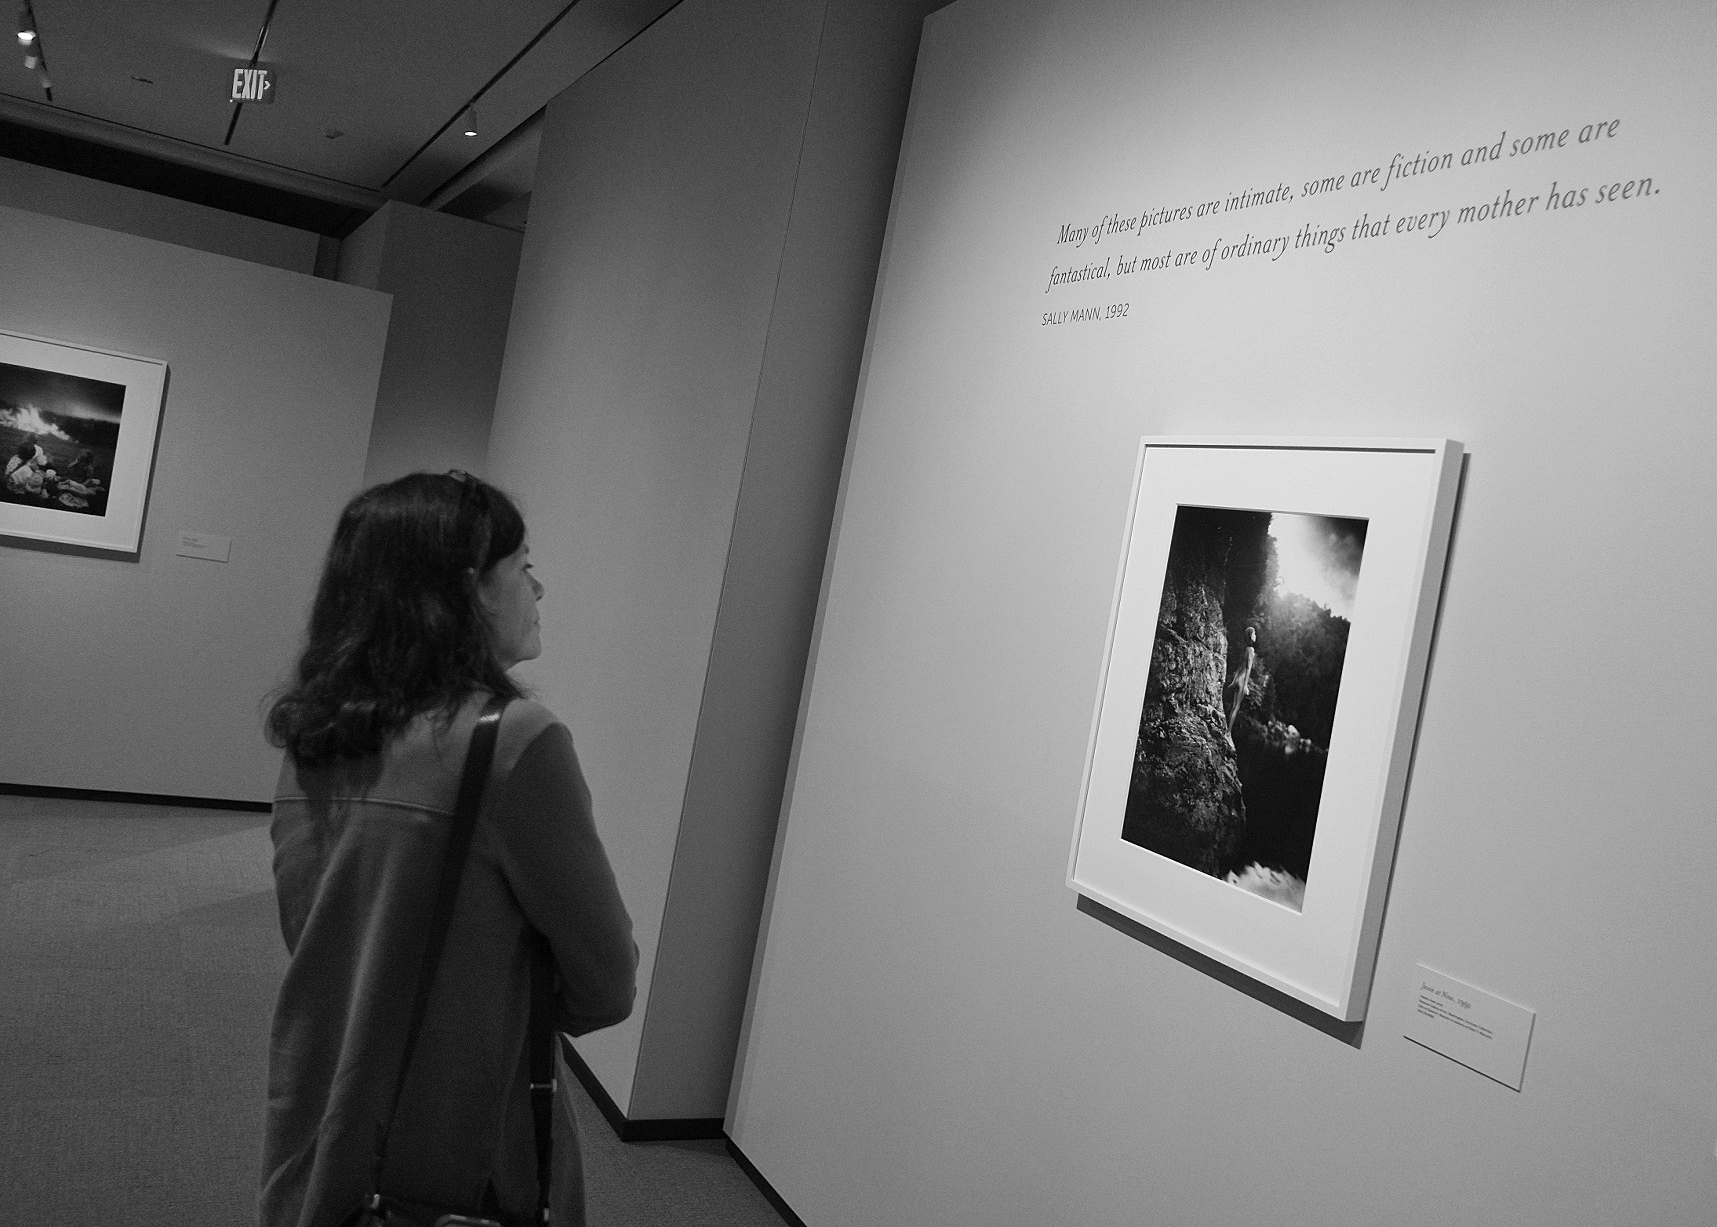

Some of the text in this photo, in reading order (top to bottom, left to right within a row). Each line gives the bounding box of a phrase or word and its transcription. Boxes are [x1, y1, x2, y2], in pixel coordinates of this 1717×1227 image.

[232, 69, 268, 100] EXIT
[1056, 119, 1621, 248] Many of these pictures are intimate, some are fiction and some are
[1045, 177, 1661, 293] fantastical, but most are of ordinary things that every mother has seen.
[1041, 302, 1130, 327] SALLY MANN, 1992
